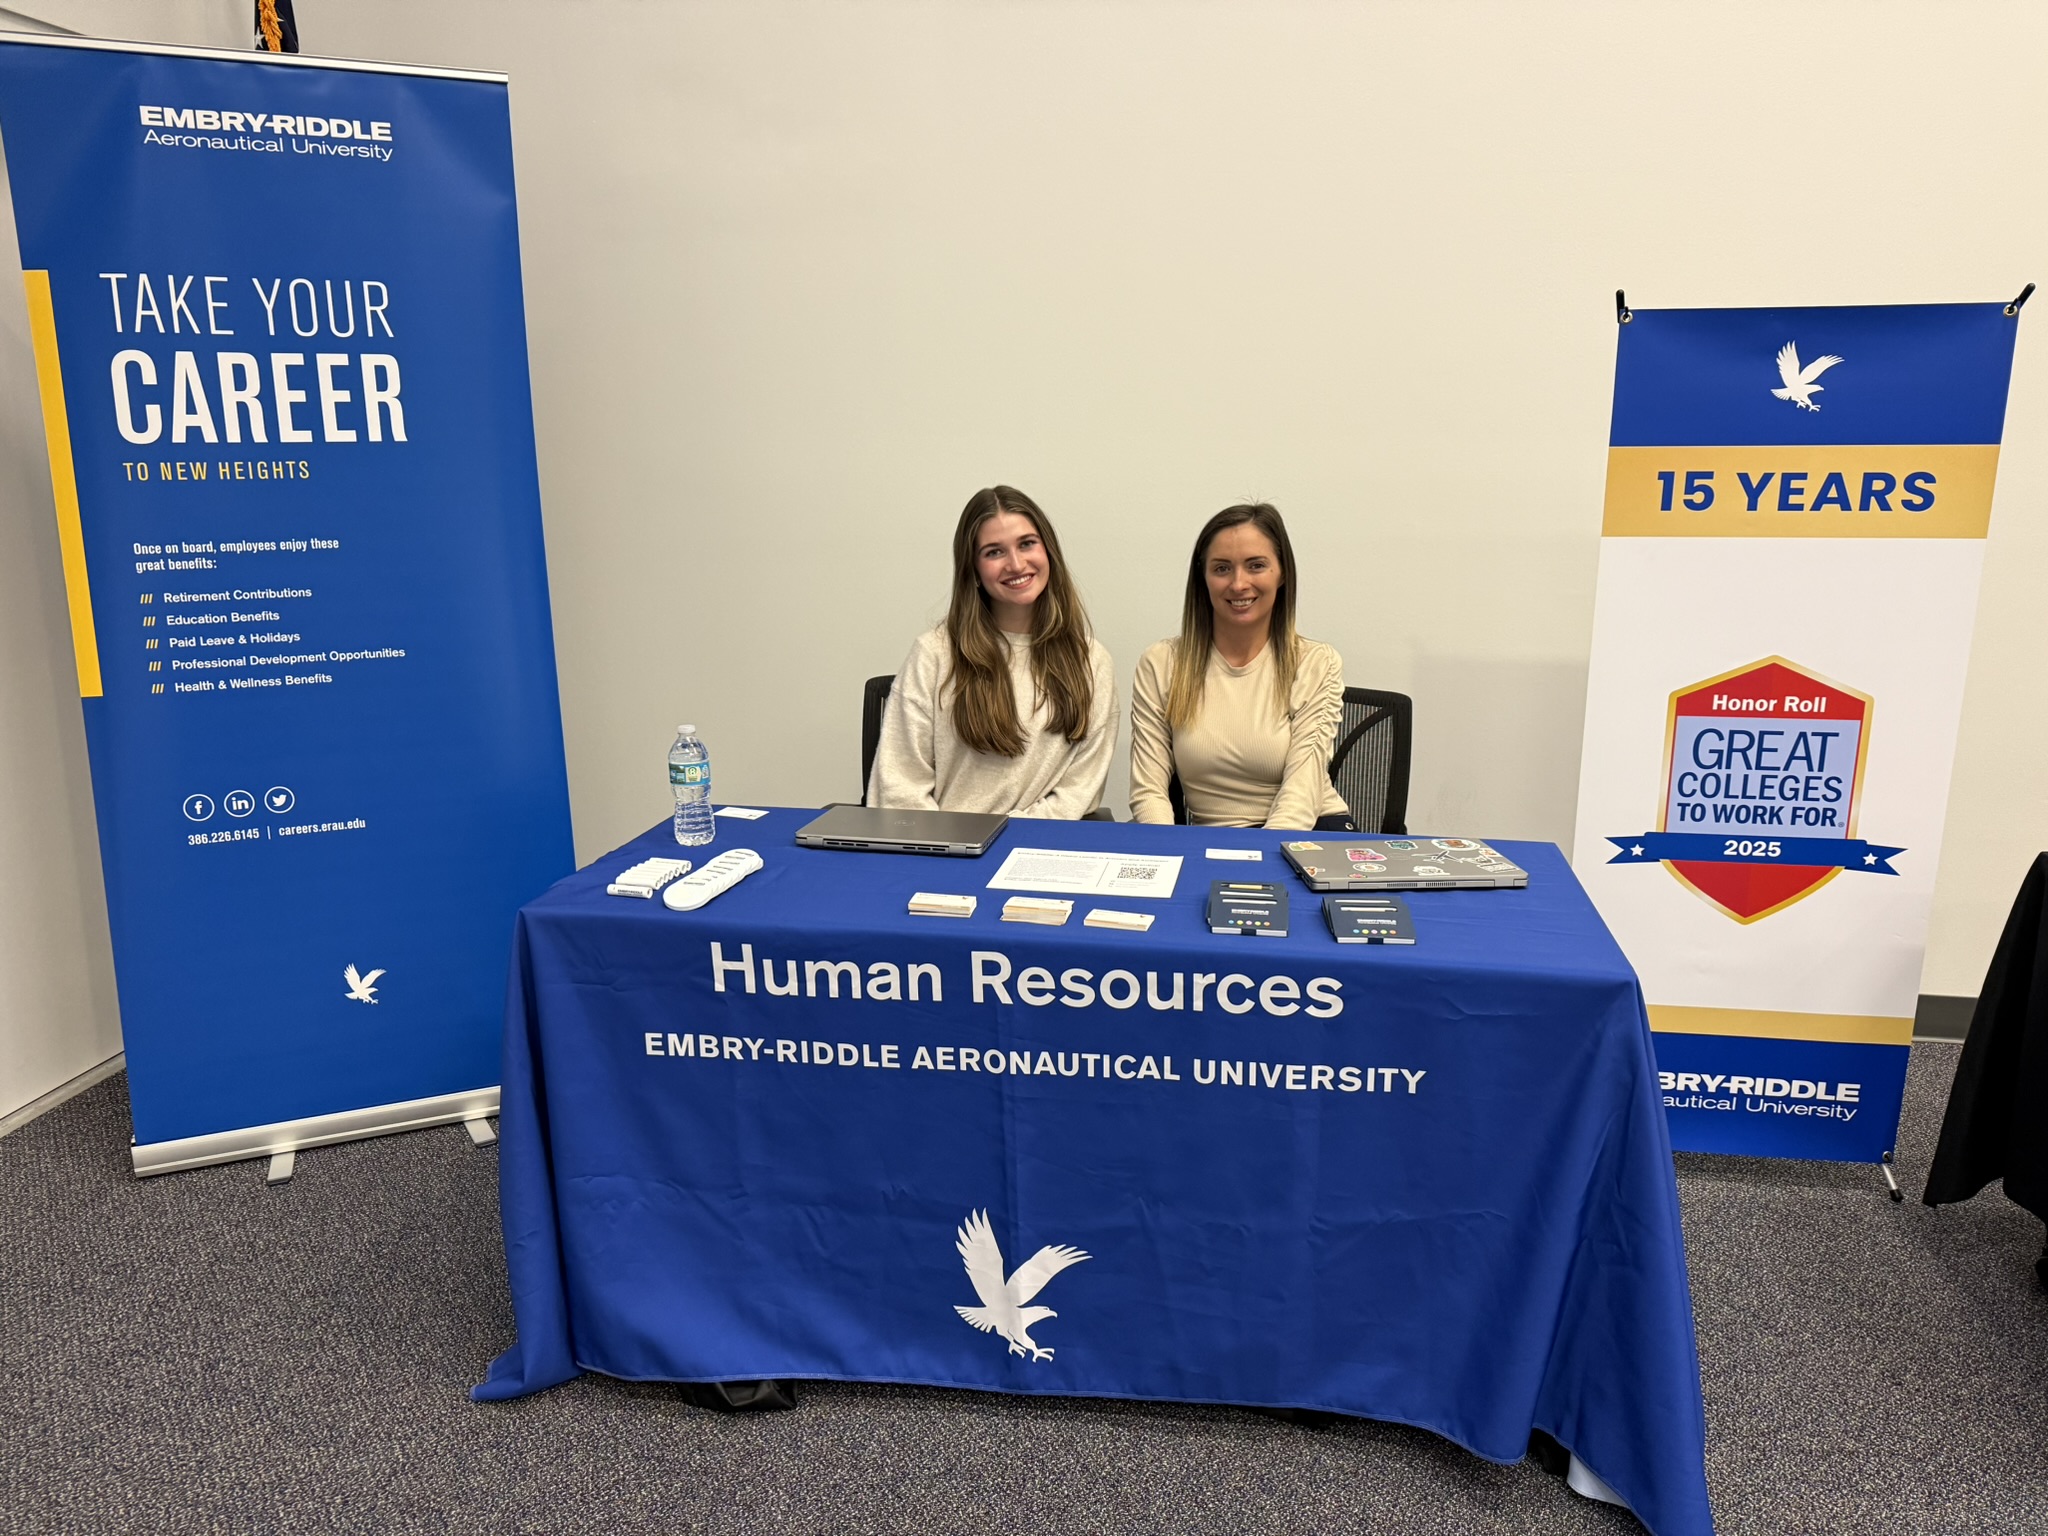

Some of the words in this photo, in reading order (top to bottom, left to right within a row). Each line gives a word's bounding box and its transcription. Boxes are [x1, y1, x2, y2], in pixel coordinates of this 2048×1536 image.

[139, 105, 393, 142] EMBRY-RIDDLE
[143, 129, 284, 153] Aeronautical
[292, 138, 393, 162] University
[99, 273, 234, 336] TAKE
[251, 277, 395, 338] YOUR
[110, 349, 408, 445] CAREER
[123, 462, 150, 482] TO
[160, 461, 207, 481] NEW
[218, 460, 310, 480] HEIGHTS
[1657, 471, 1716, 512] 15
[1736, 471, 1937, 512] YEARS
[133, 542, 162, 555] Once
[165, 544, 179, 554] on
[182, 540, 217, 554] board,
[220, 540, 277, 554] employees
[280, 538, 308, 552] enjoy
[310, 538, 340, 549] these
[136, 558, 166, 574] great
[168, 557, 218, 570] benefits:
[163, 590, 231, 603] Retirement
[233, 587, 312, 600] Contributions
[166, 614, 228, 626] Education
[231, 610, 281, 622] Benefits
[169, 637, 196, 648] Paid
[200, 635, 235, 646] Leave
[238, 634, 247, 644] &
[250, 632, 301, 644] Holidays
[172, 656, 247, 670] Professional
[249, 651, 327, 666] Development
[329, 647, 406, 663] Opportunities
[175, 681, 215, 693] Health
[218, 680, 227, 690] &
[229, 676, 282, 690] Wellness
[285, 673, 333, 686] Benefits
[1712, 694, 1778, 712] Honor
[1783, 696, 1827, 713] Roll
[1692, 728, 1840, 773] GREAT
[1677, 772, 1843, 803] COLLEGES
[1677, 803, 1706, 823] TO
[1712, 803, 1785, 826] WORK
[188, 828, 260, 846] 386.226.6145
[278, 818, 366, 836] careers.erau.edu
[1723, 840, 1782, 858] 2025
[709, 941, 943, 1002] Human
[970, 950, 1345, 1019] Resources
[644, 1032, 901, 1068] EMBRY-RIDDLE
[911, 1045, 1181, 1081] AERONAUTICAL
[1193, 1058, 1427, 1094] UNIVERSITY
[1658, 1071, 1861, 1103] BRY-RIDDLE
[1663, 1095, 1737, 1111] autical
[1745, 1097, 1858, 1122] University
